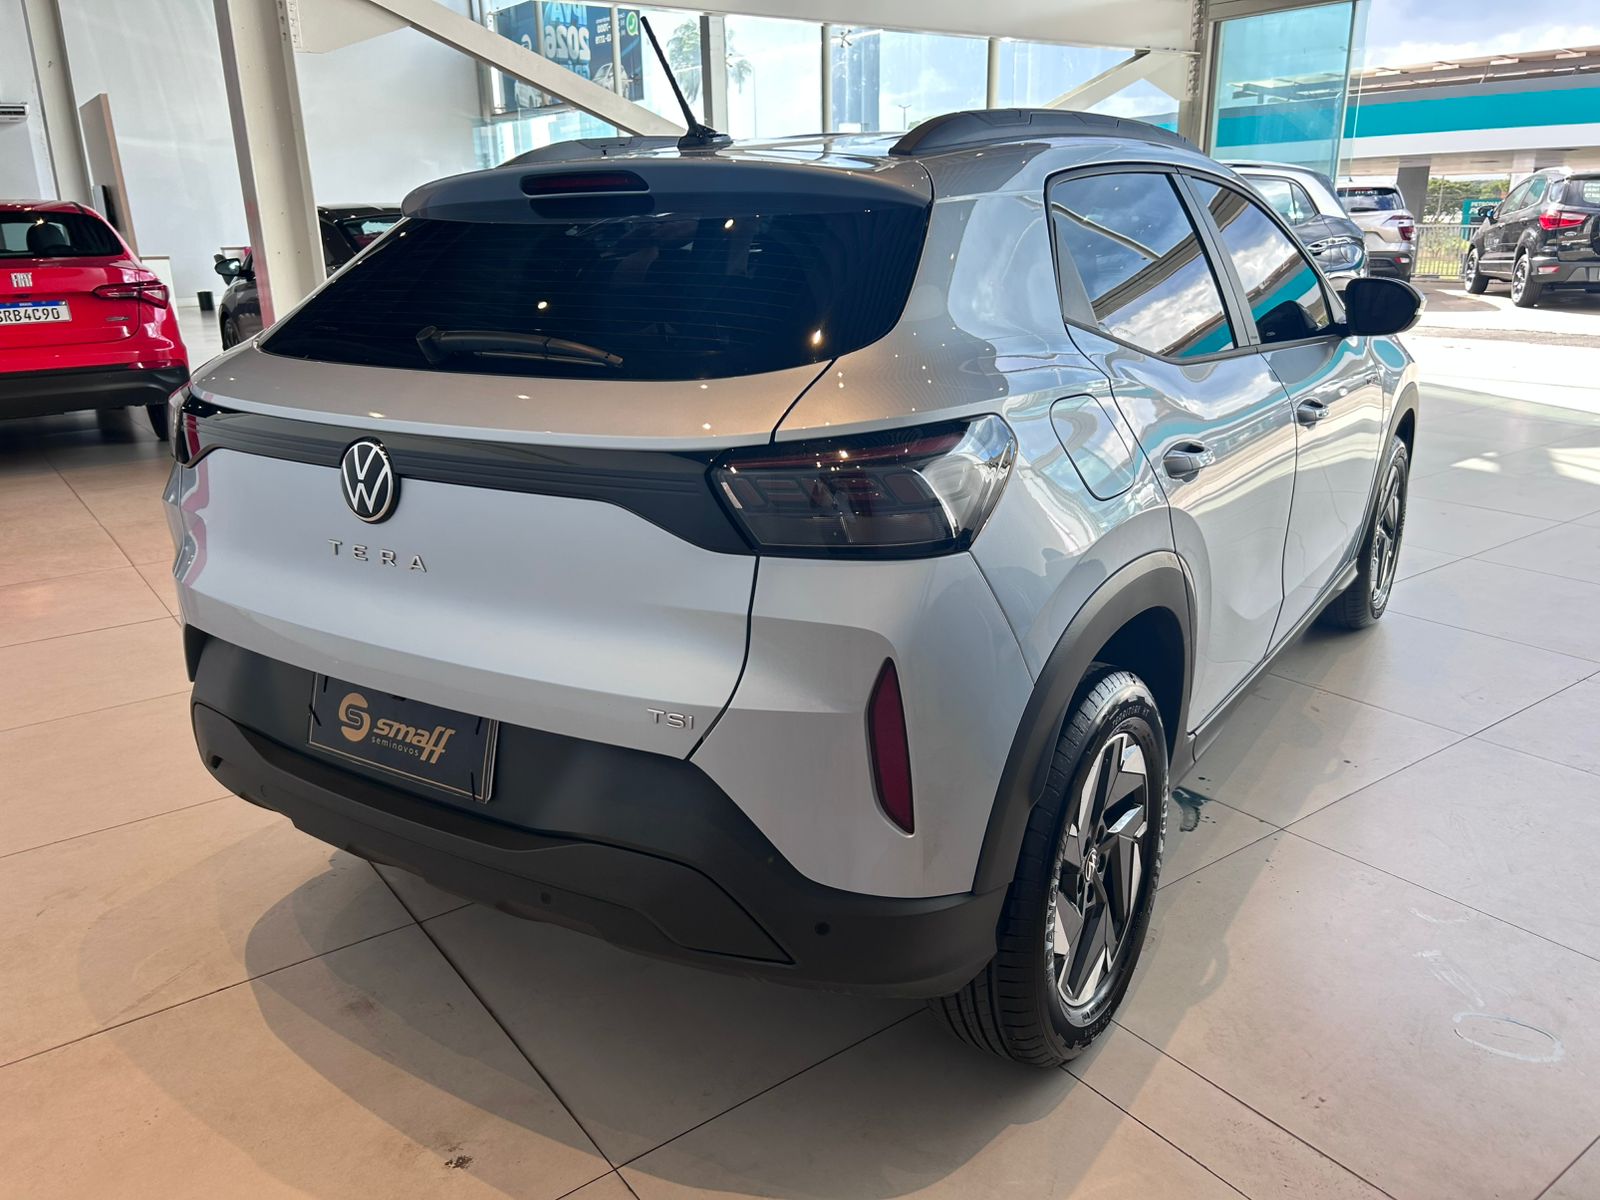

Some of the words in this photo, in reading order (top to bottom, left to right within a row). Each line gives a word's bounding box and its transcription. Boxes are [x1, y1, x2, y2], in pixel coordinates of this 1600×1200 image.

[10, 272, 33, 288] FIAT
[328, 538, 427, 572] TERA
[647, 707, 695, 730] TSI
[371, 735, 419, 757] seminovos
[373, 718, 457, 764] smaff
